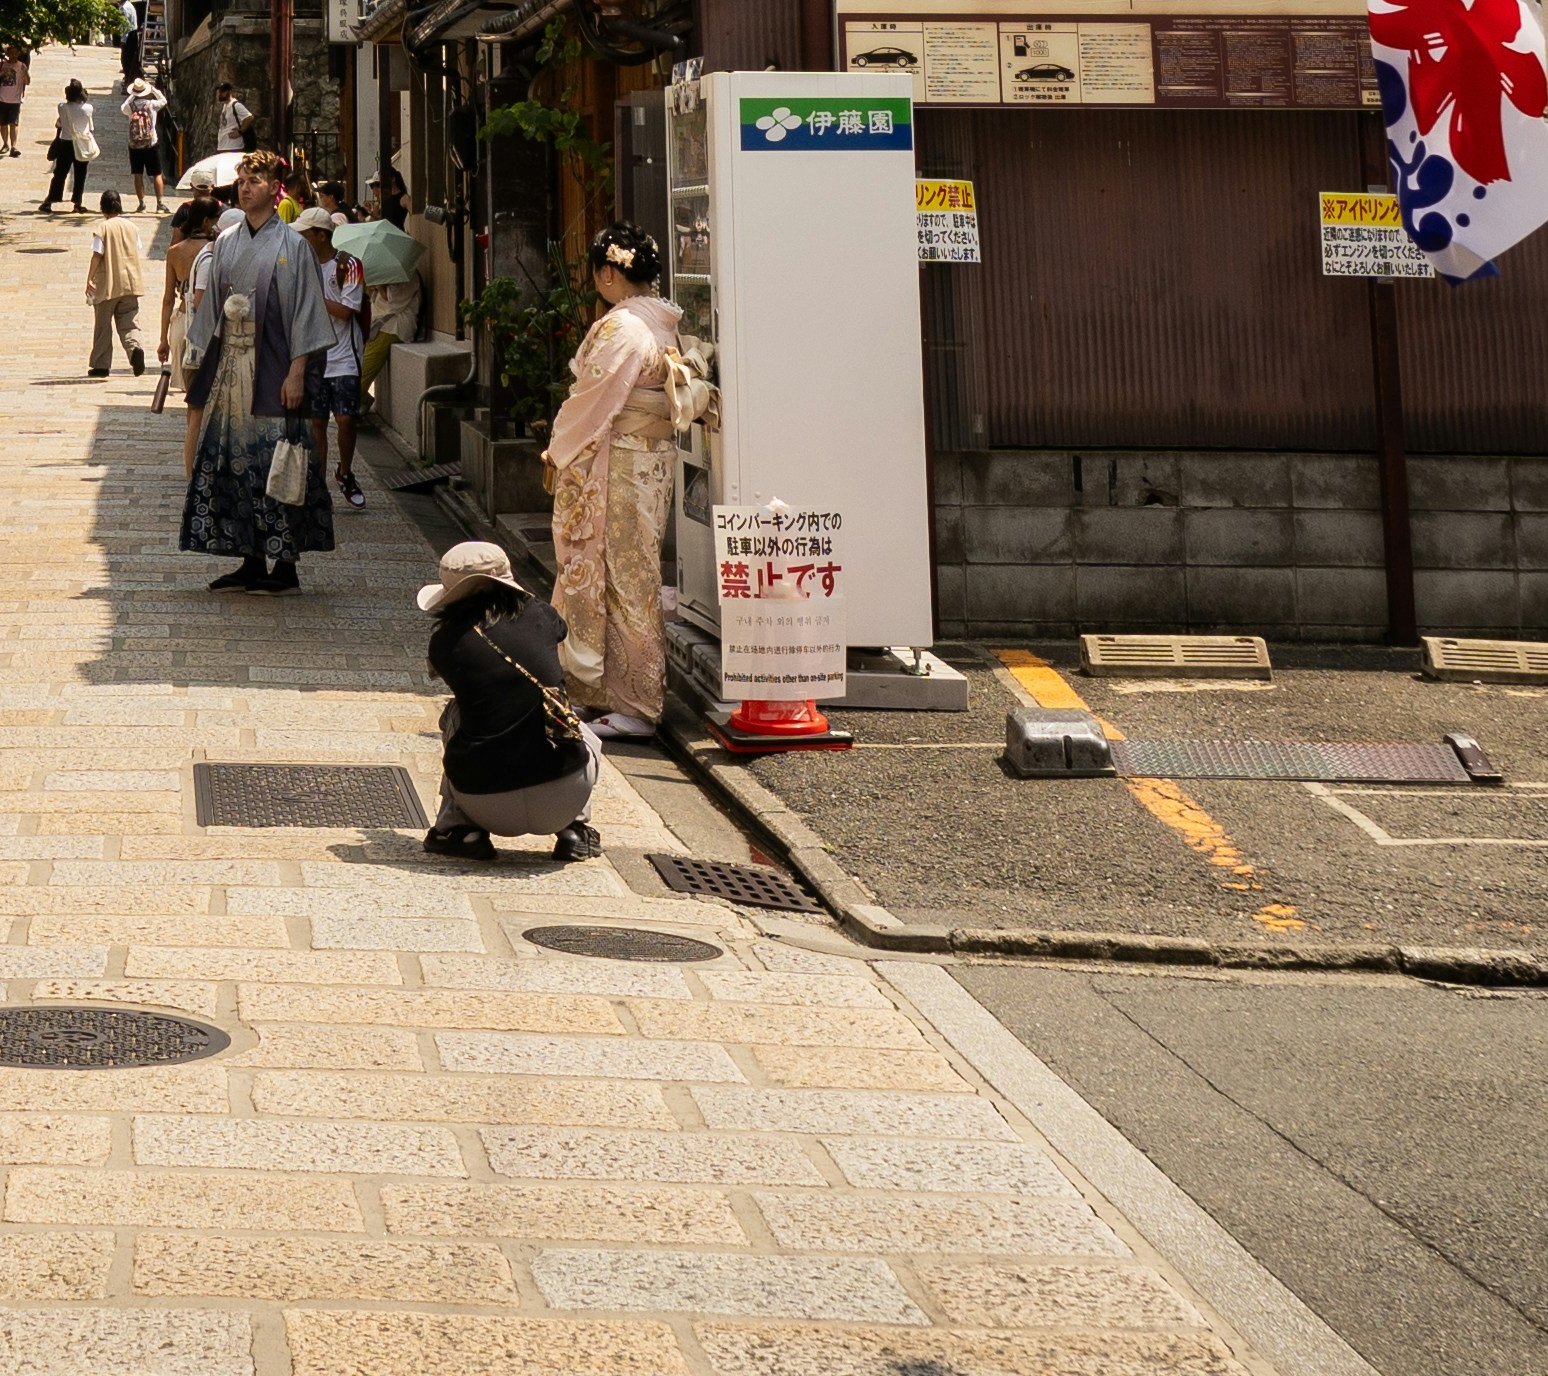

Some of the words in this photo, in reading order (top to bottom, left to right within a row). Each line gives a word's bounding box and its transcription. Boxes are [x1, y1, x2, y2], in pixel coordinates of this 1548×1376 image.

[806, 108, 894, 137] 伊藤園
[726, 536, 833, 557] 駐車以外の行為は
[720, 560, 842, 599] 禁止です
[724, 671, 753, 683] Prohibited
[754, 673, 782, 684] activities
[782, 674, 798, 684] other
[798, 673, 810, 683] than
[810, 673, 827, 683] on-site
[827, 671, 844, 684] parking
